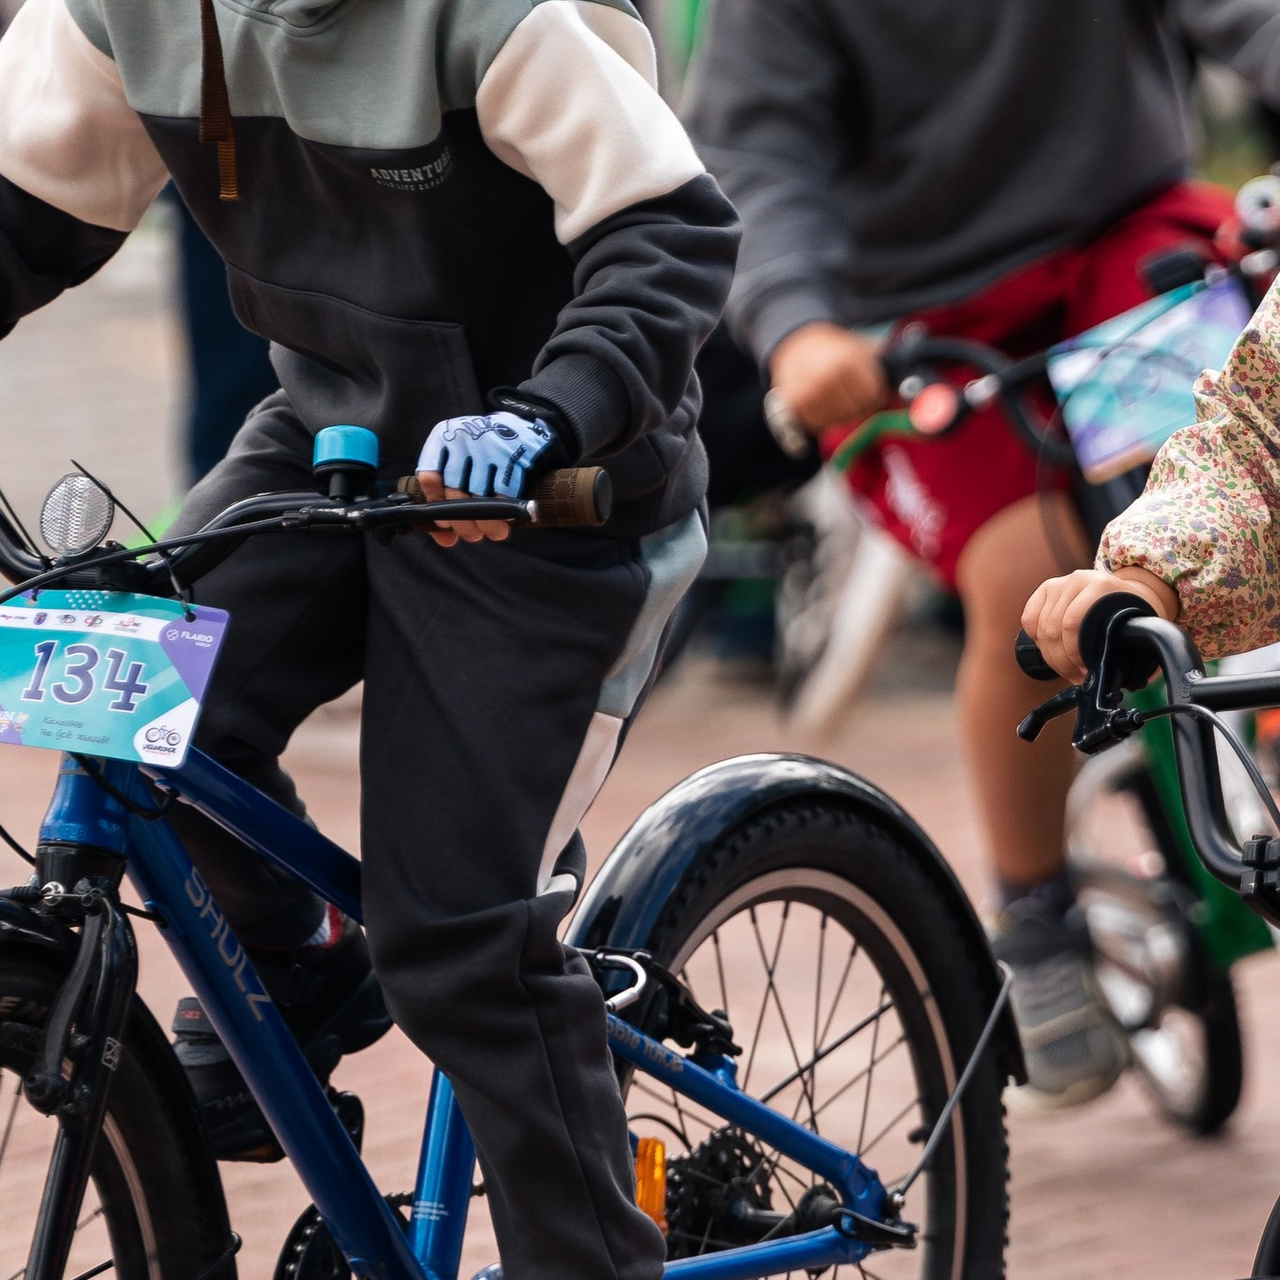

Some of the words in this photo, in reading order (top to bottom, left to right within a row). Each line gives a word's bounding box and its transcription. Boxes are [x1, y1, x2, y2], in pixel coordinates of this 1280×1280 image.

[180, 630, 214, 643] FLARIO
[20, 639, 150, 714] 134
[184, 865, 272, 1022] SHULZ
